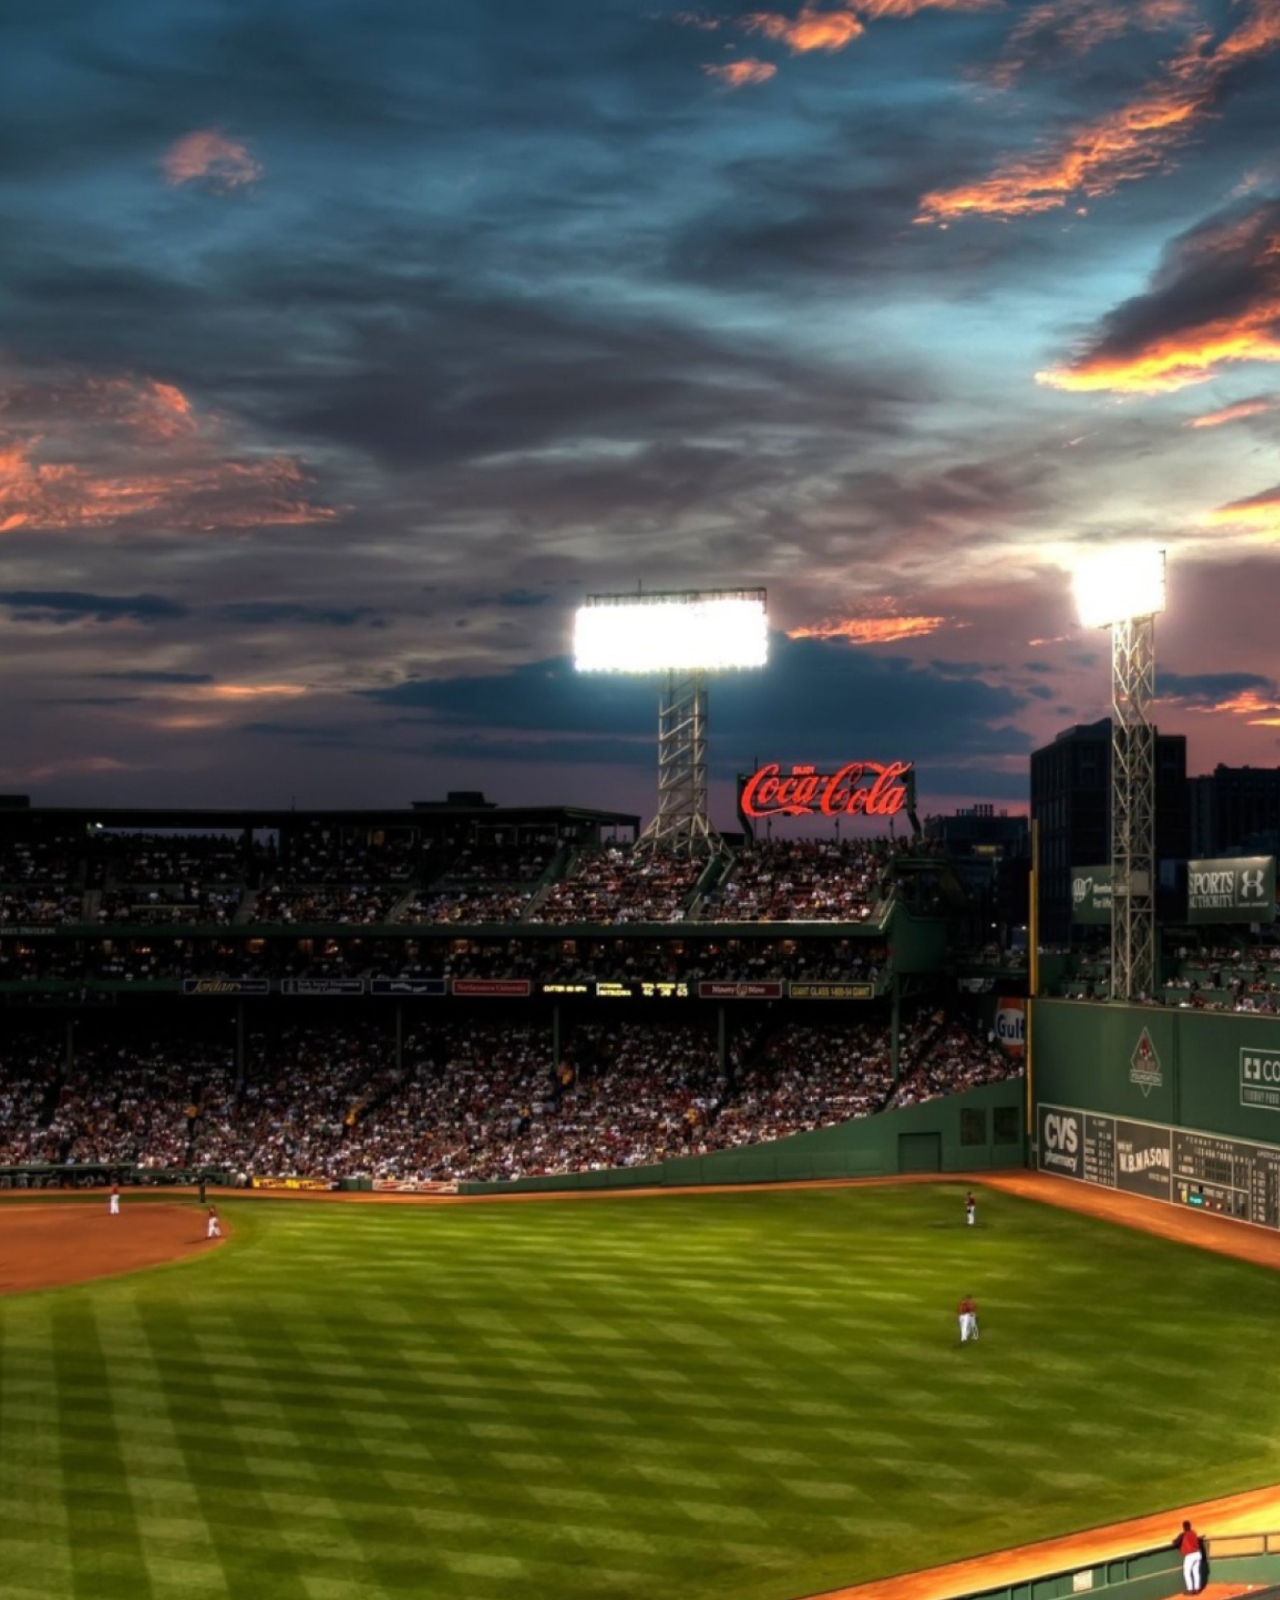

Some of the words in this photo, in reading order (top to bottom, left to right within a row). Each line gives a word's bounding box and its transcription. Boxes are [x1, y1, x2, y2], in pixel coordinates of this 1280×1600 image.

[741, 761, 914, 817] Coca-Cola
[1189, 870, 1234, 895] SPORTS
[1044, 1113, 1079, 1153] CVS
[1044, 1149, 1079, 1172] pharmacy
